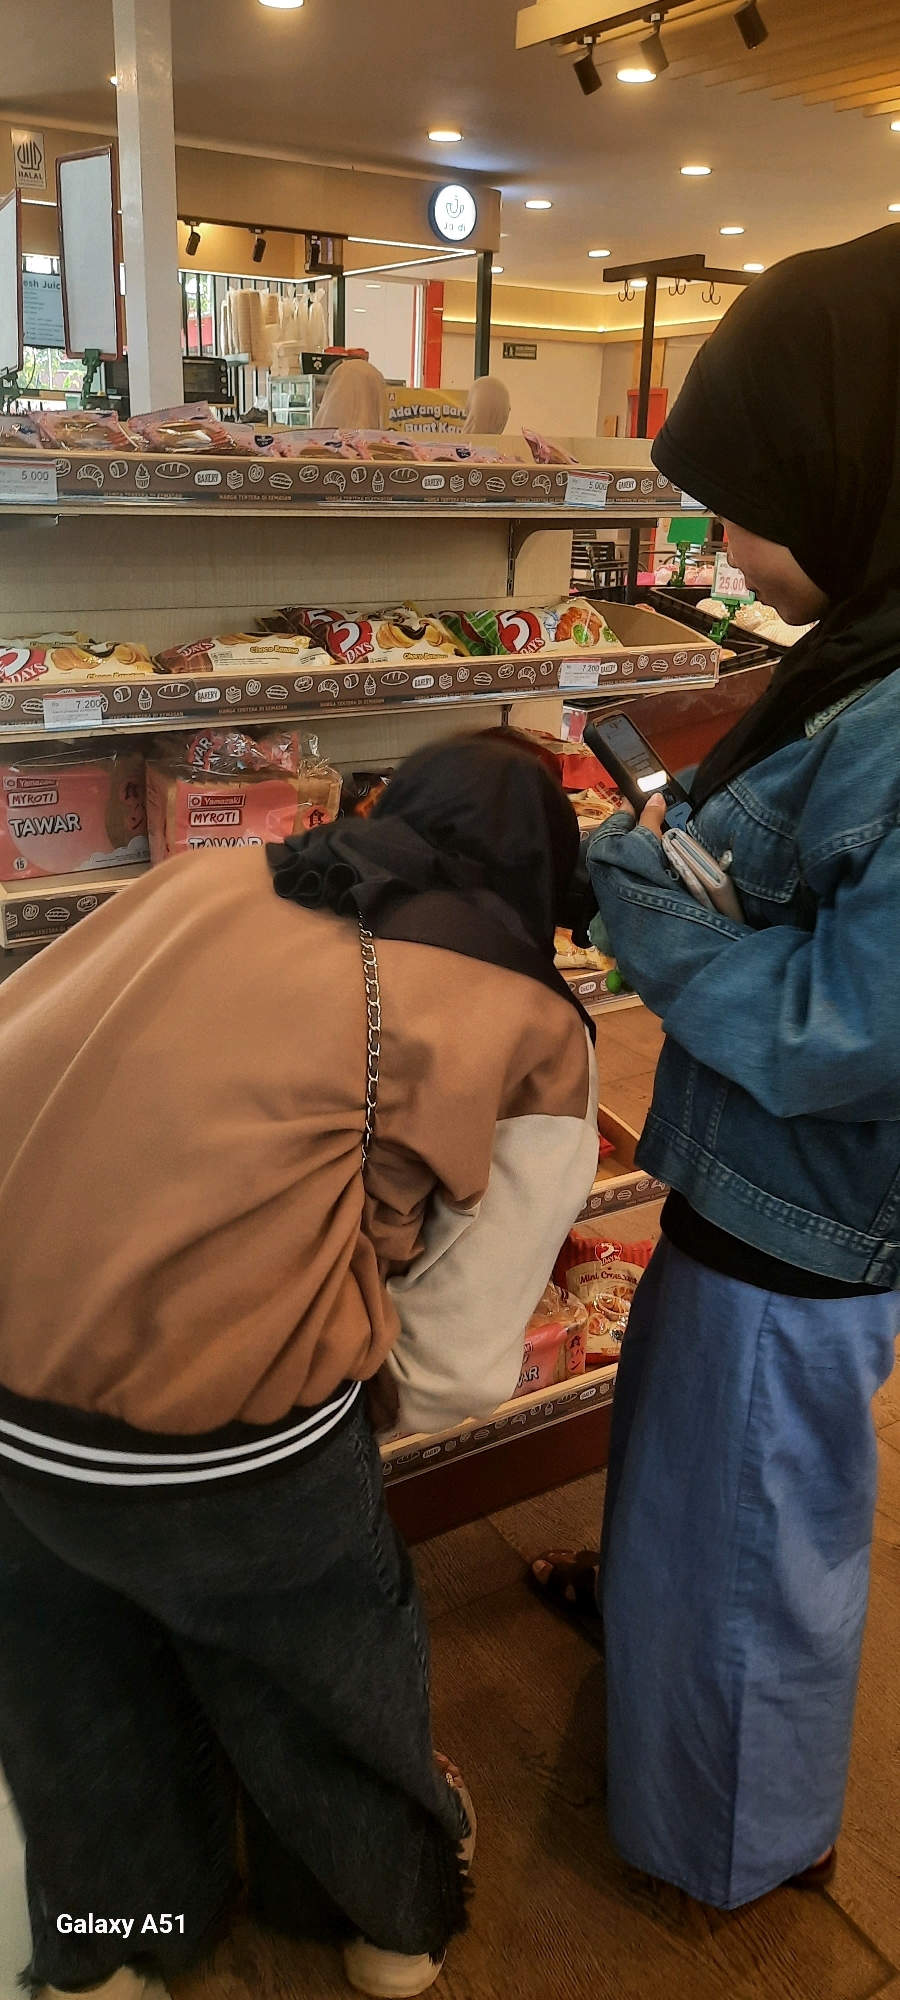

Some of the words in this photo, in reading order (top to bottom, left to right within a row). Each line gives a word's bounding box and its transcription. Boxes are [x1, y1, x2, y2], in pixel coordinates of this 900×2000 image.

[18, 171, 43, 180] HALAL
[405, 421, 437, 433] Buat
[197, 473, 219, 483] BAKERY
[333, 622, 360, 652] 5
[500, 610, 530, 652] 5
[182, 641, 215, 657] DAYS
[250, 646, 273, 654] Choco
[274, 645, 300, 655] Banana
[520, 636, 545, 655] DAYS
[346, 641, 374, 664] DAYS
[10, 662, 48, 683] DAYS
[197, 690, 218, 700] BAKERY
[12, 793, 53, 805] MYROTI
[204, 796, 241, 806] Yamazaki
[193, 811, 236, 824] MYROTI
[8, 813, 82, 838] TAWAR
[16, 860, 25, 870] 15
[580, 1272, 600, 1284] Mini
